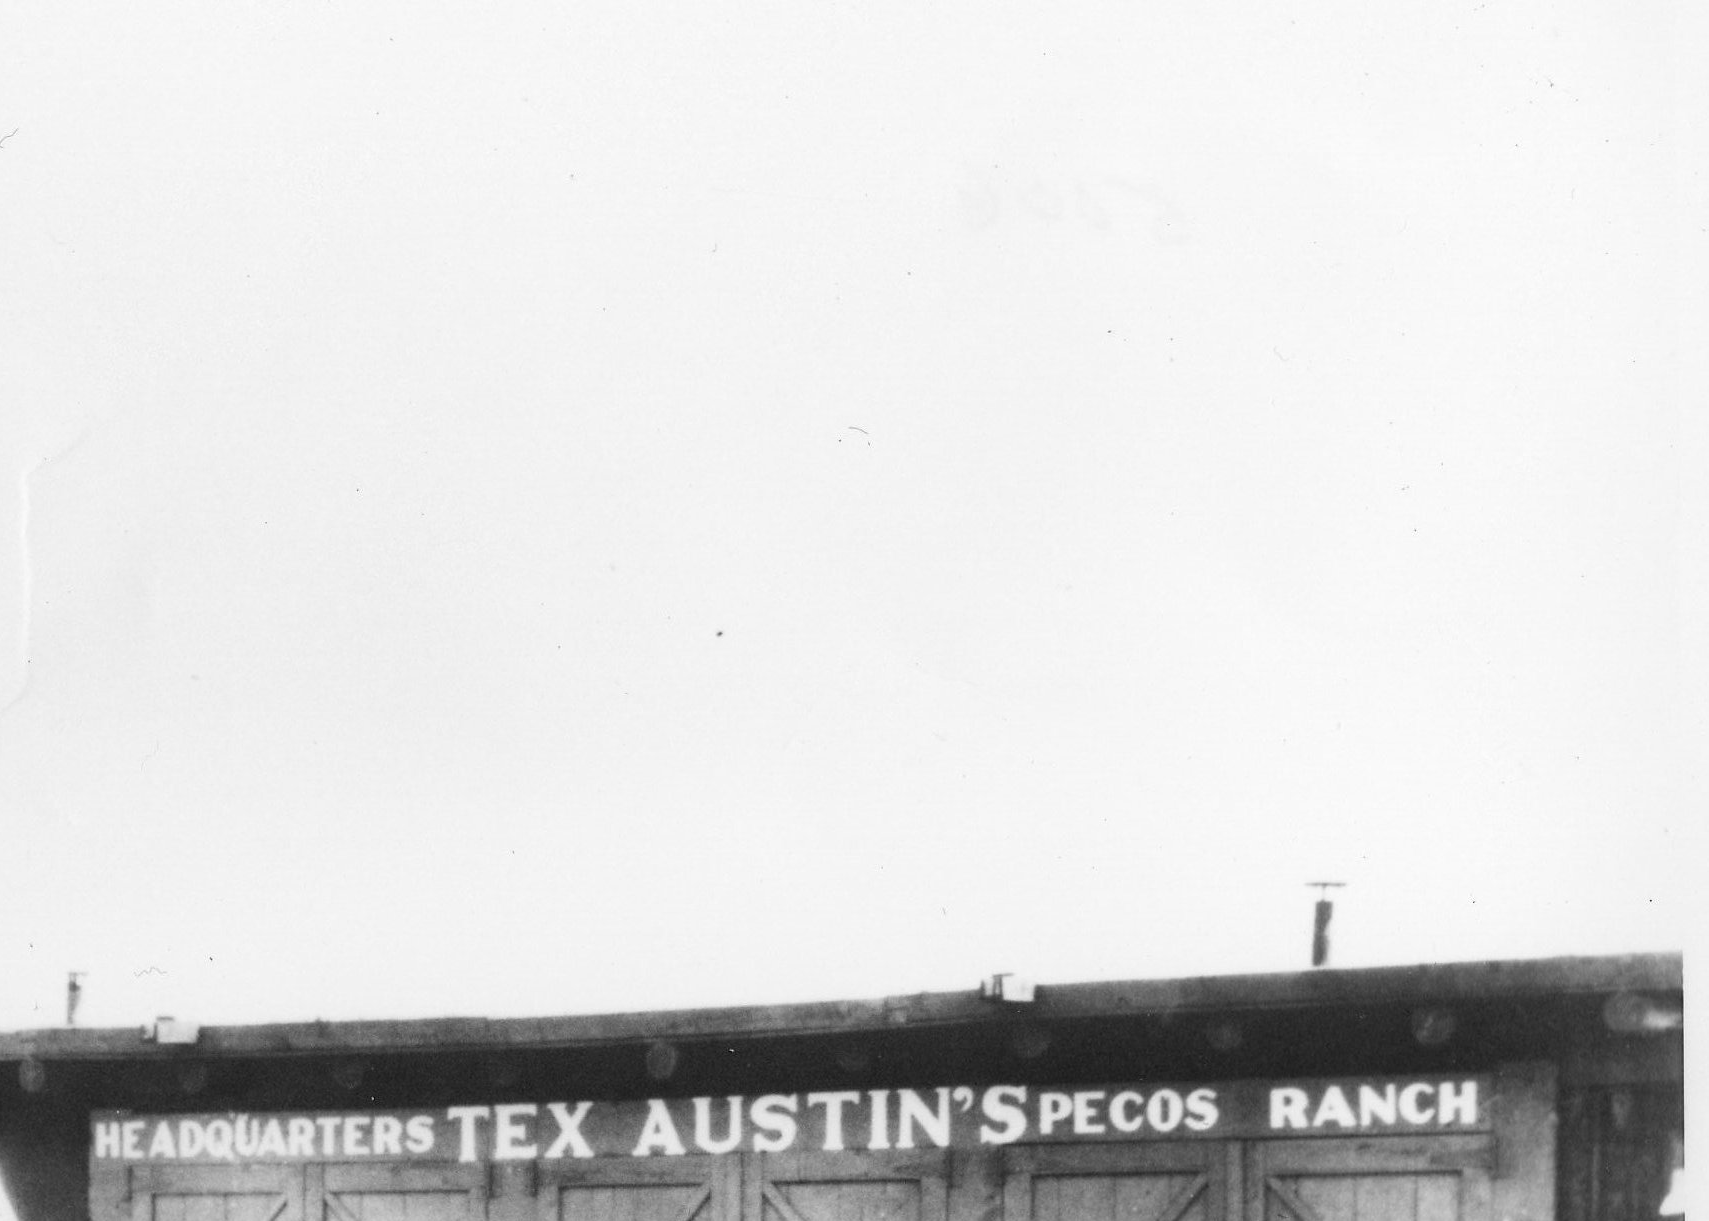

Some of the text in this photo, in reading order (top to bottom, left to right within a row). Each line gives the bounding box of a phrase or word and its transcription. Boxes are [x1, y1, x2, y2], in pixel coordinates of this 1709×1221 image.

[94, 1080, 1479, 1164] HEADQUARTERS TEX AUSTIN'S PECOS RANCH
